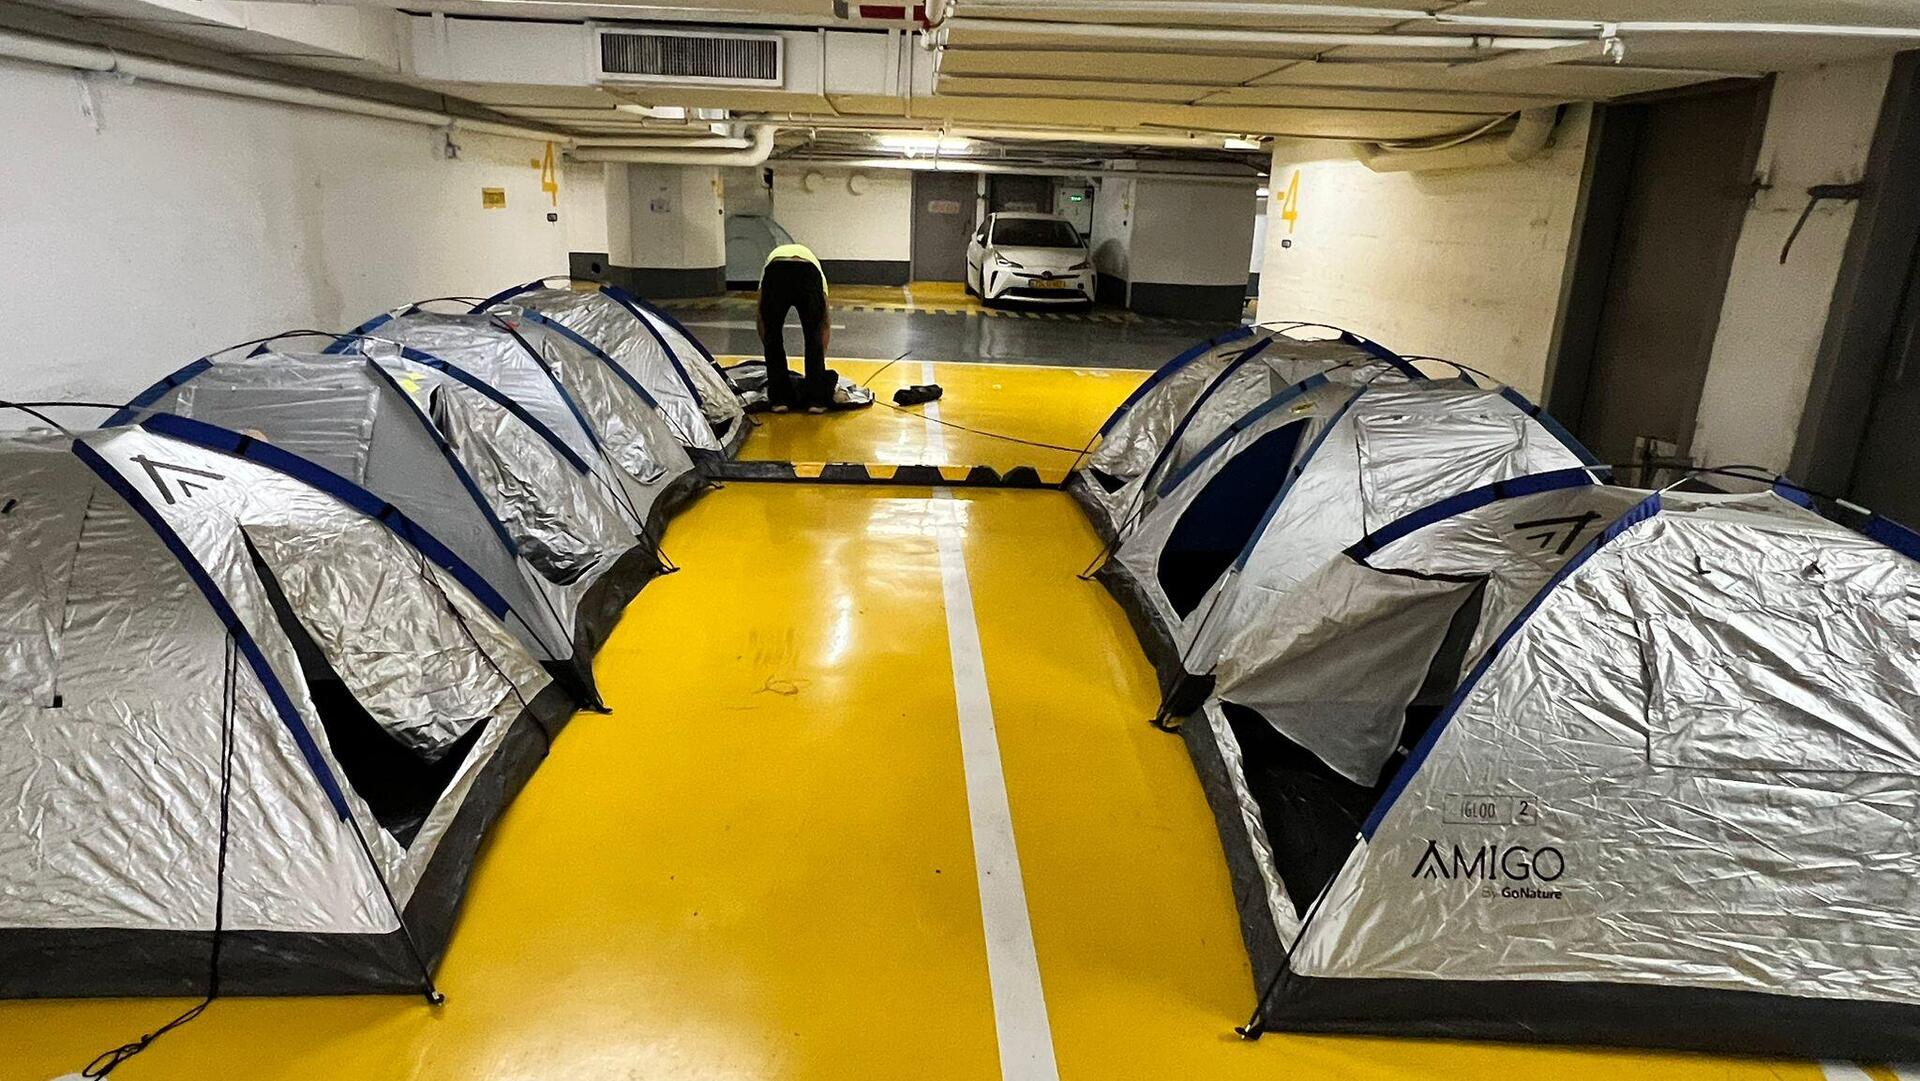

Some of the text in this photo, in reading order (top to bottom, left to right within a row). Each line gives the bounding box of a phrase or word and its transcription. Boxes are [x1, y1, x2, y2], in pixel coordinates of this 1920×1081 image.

[1460, 800, 1529, 818] IGLOO 2
[1411, 839, 1565, 881] AMIGO
[1501, 886, 1563, 900] GoNature
